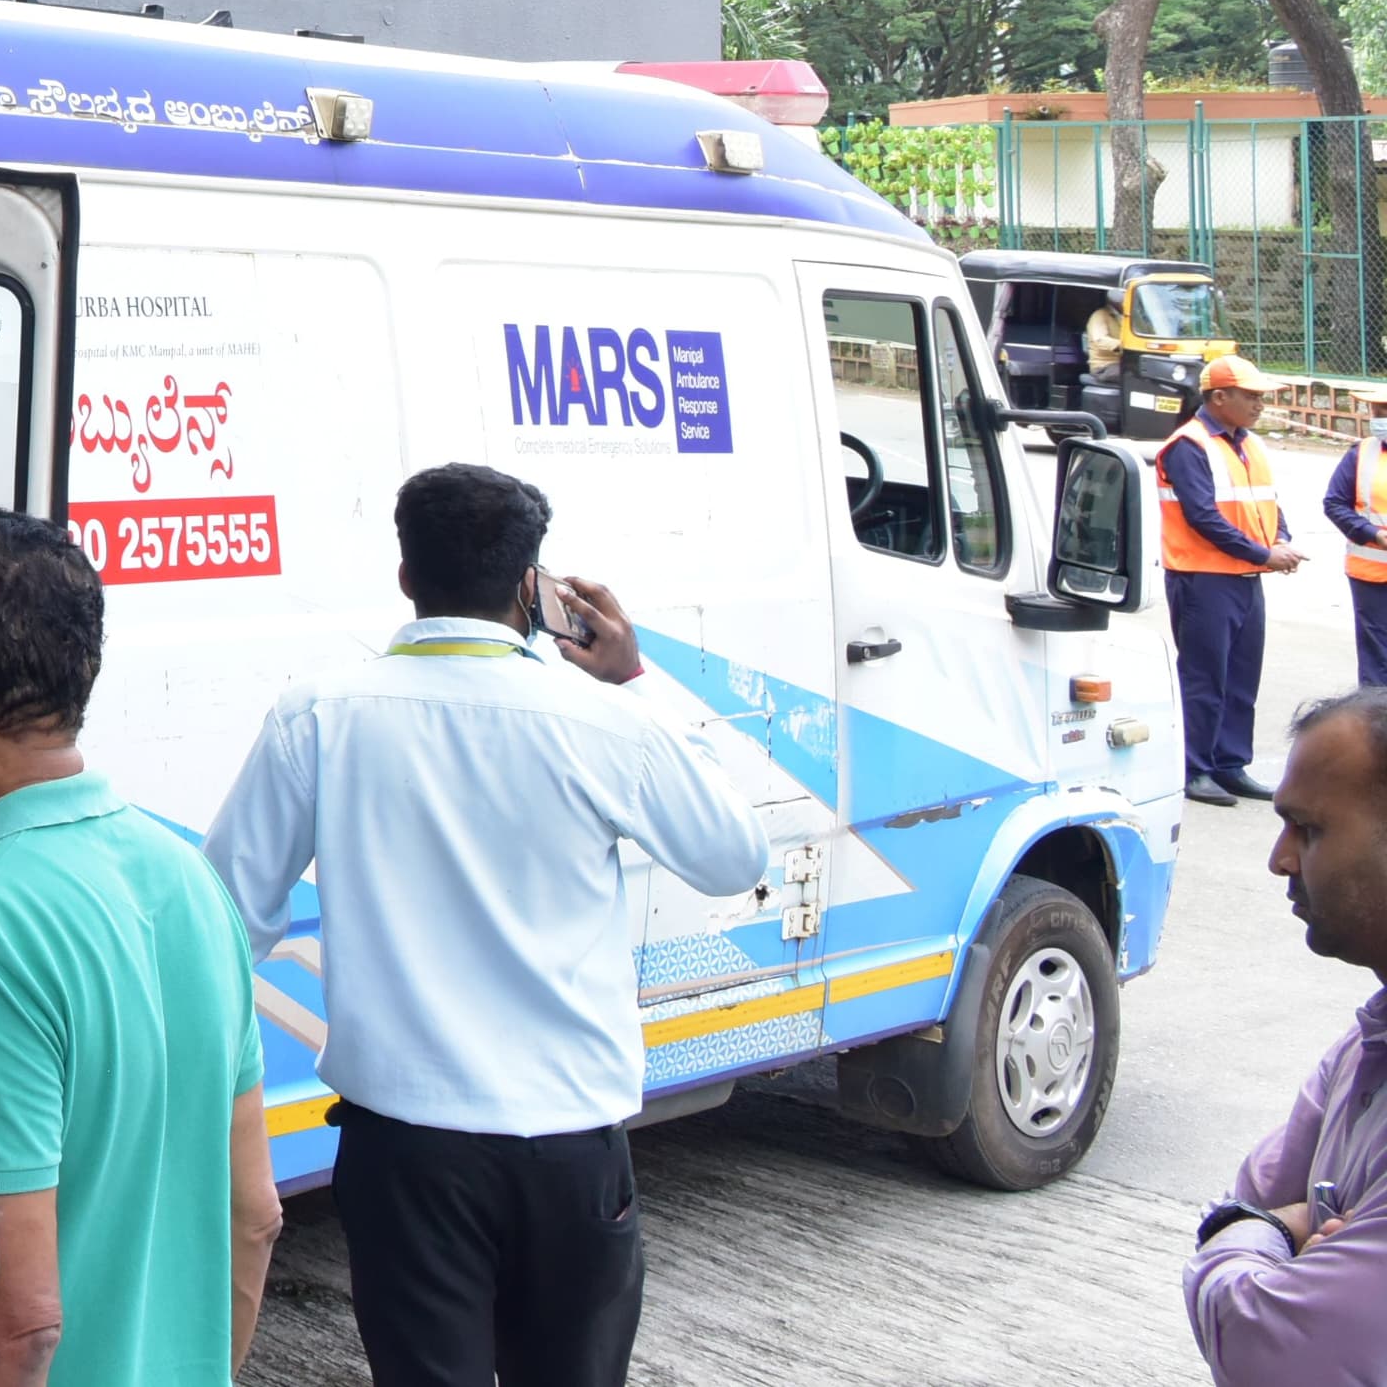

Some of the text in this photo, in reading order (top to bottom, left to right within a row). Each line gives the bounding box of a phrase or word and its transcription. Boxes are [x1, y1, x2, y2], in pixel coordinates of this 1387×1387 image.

[125, 296, 213, 318] HOSPITAL
[121, 344, 147, 359] KMC
[673, 345, 704, 366] Manipal
[503, 323, 667, 428] MARS
[676, 372, 720, 390] Ambulance
[678, 396, 718, 415] Response
[680, 422, 710, 440] Service
[118, 512, 271, 570] 2575555
